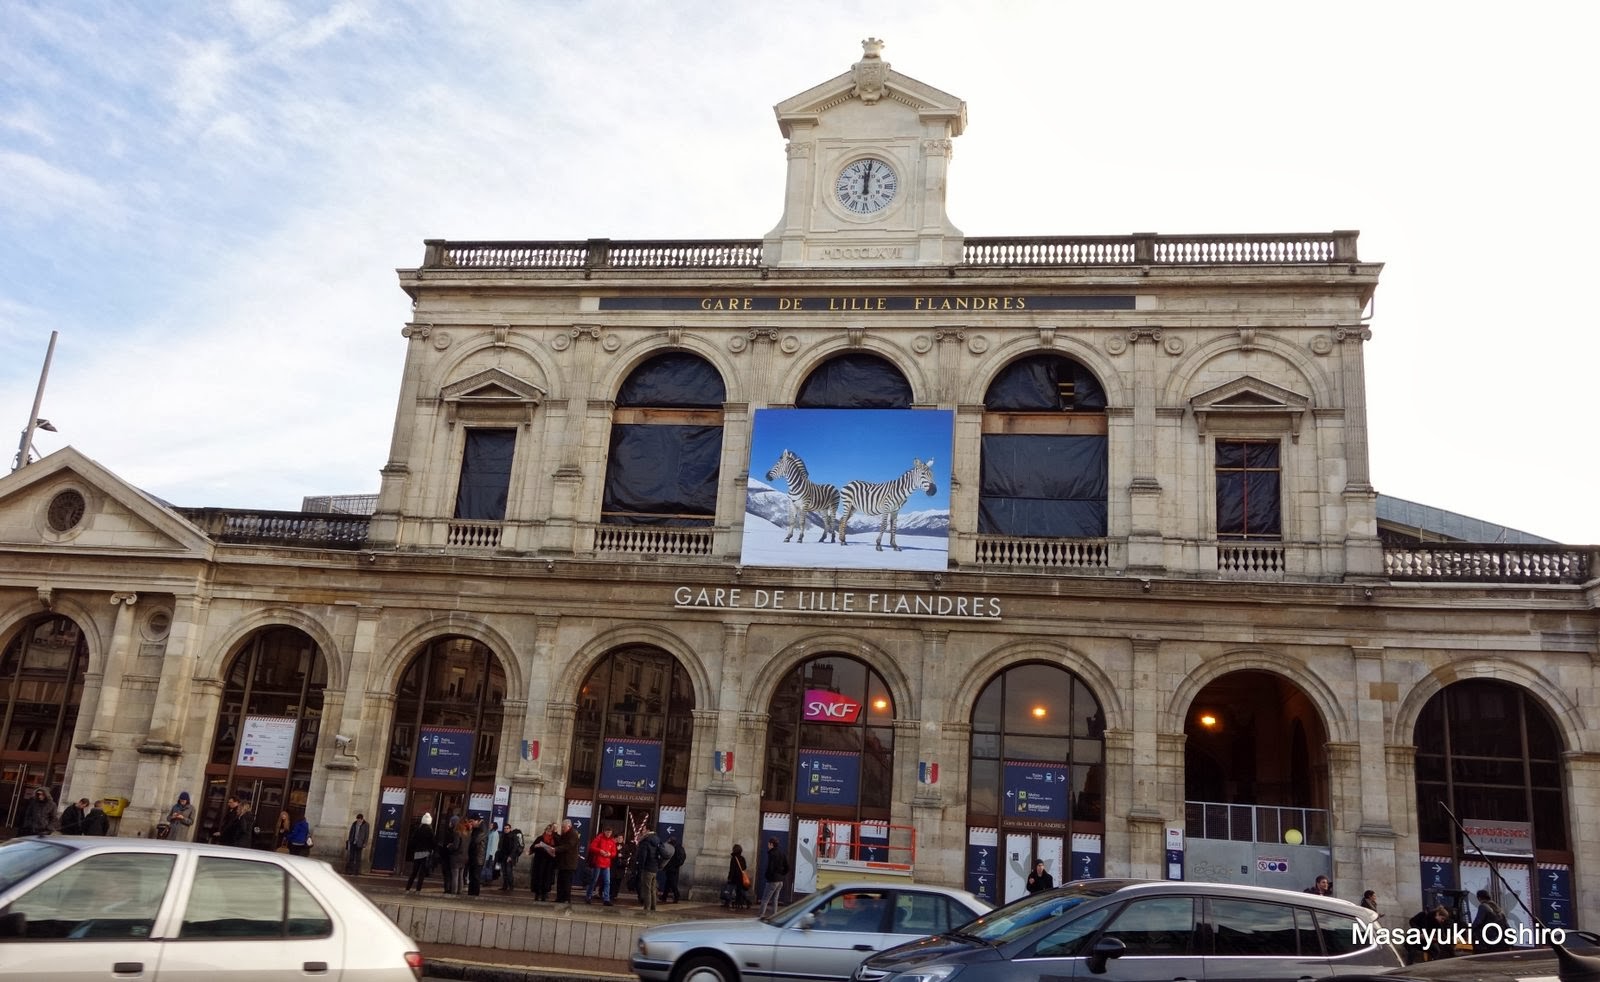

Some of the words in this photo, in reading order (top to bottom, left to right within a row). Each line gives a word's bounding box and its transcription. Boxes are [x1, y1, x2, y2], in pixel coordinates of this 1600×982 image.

[701, 298, 753, 310] GARE
[778, 298, 804, 310] DE
[829, 298, 888, 310] LILLE
[914, 297, 1026, 310] FLANDRES
[674, 586, 741, 607] GARE
[755, 589, 785, 609] DE
[798, 591, 854, 612] LILLE
[868, 593, 1001, 617] FLANDRES
[806, 702, 857, 717] SNCF
